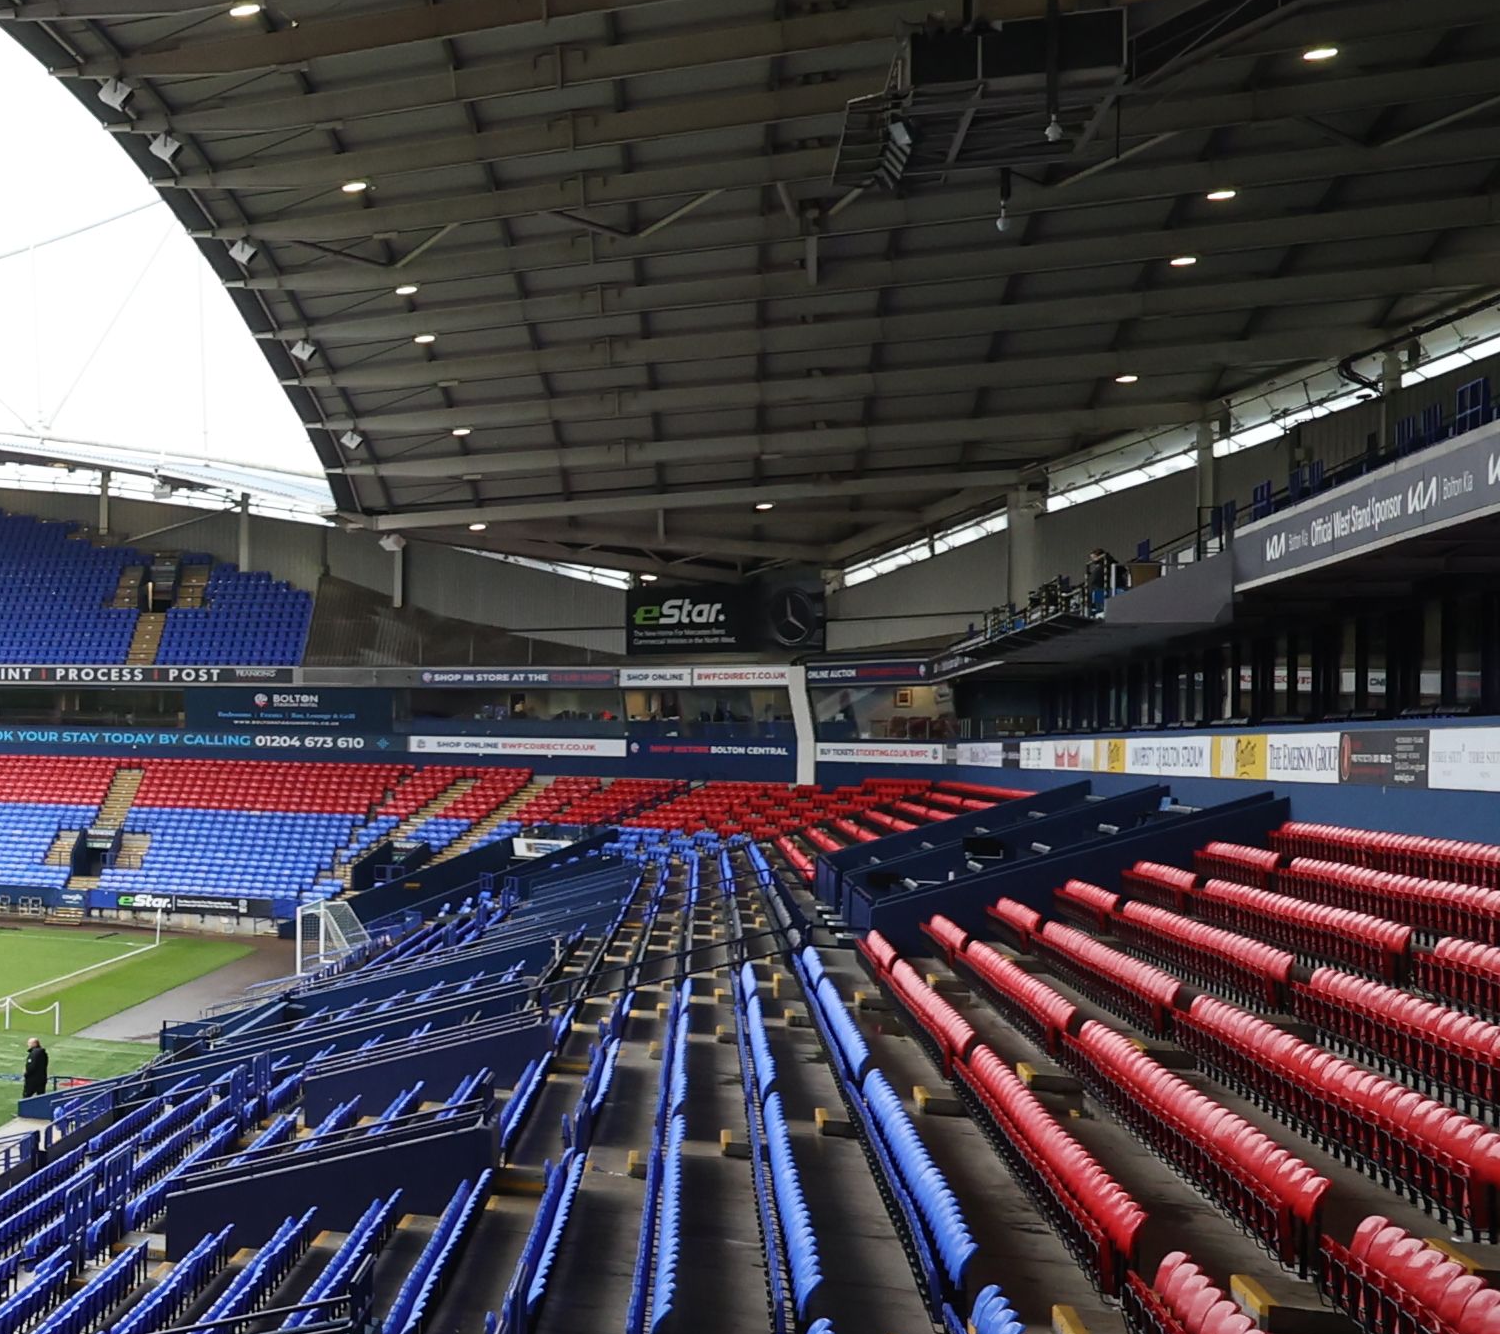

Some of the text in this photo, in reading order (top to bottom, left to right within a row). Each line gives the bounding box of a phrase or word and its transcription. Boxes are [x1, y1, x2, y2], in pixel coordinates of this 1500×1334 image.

[1311, 493, 1403, 547] Official West Sponsor
[56, 669, 143, 681] PROCESS
[168, 669, 220, 681] POST
[433, 673, 548, 682] SHOP IN STORE AT THE
[626, 673, 684, 682] SHOP ONLINE
[697, 671, 787, 681] BWFCDIRECT.CO.UK
[807, 669, 830, 679] ONLINE
[831, 668, 857, 679] AUCTION
[272, 693, 319, 704] BOLTON
[17, 730, 59, 742] YOUR
[62, 731, 99, 743] STAY
[102, 732, 155, 745] TODAY
[158, 733, 179, 745] BY
[184, 734, 251, 747] CALLING
[255, 735, 301, 748] 01204
[304, 736, 334, 748] 673
[337, 737, 364, 749] 610
[436, 740, 597, 752] SHOP ONLINE BWFCDIRECT.CO.UK
[711, 746, 788, 756] BOLTON CENTRAL
[831, 748, 855, 756] TICKETS
[1283, 742, 1314, 771] EMERSON
[1315, 741, 1339, 773] GROUP
